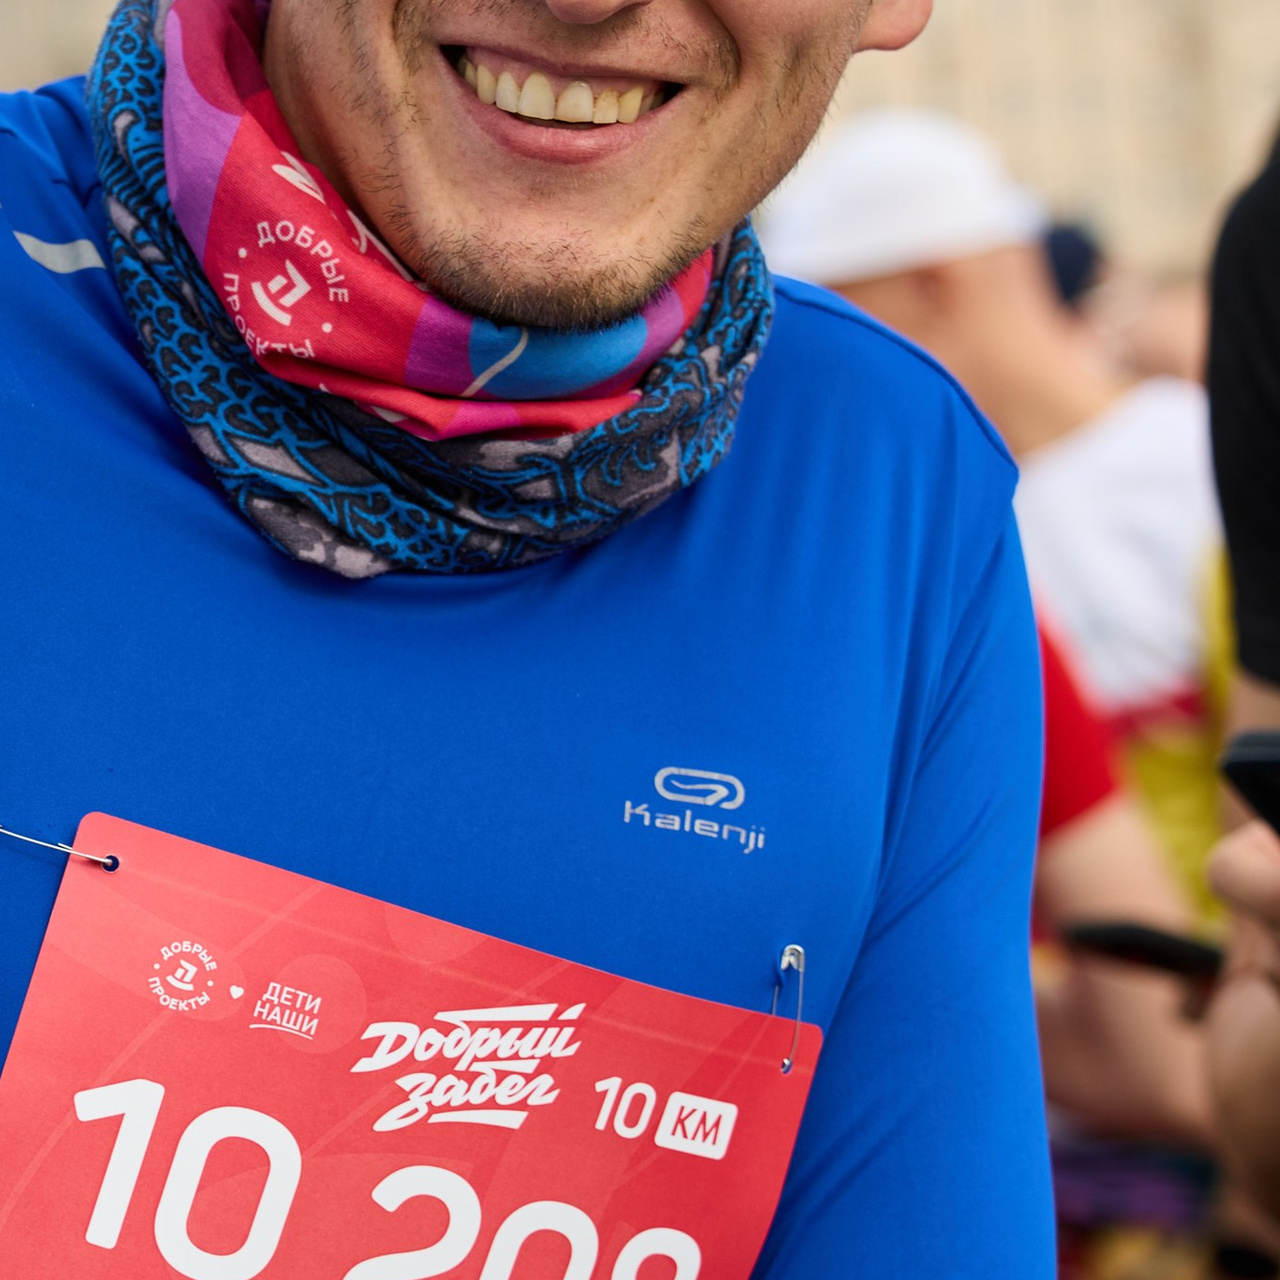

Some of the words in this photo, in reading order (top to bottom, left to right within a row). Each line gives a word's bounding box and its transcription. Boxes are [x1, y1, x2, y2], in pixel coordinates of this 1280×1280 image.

[256, 220, 349, 303] ДОБРЫЕ
[623, 800, 766, 854] Kalenji
[160, 940, 218, 972] ДОБРЫЕ
[147, 976, 211, 1012] ПРОЕКТЫ
[252, 1000, 319, 1036] НАШИ
[262, 981, 323, 1015] ДЕТИ
[349, 1002, 587, 1073] Добрый
[372, 1058, 561, 1132] забег
[594, 1076, 657, 1139] 10
